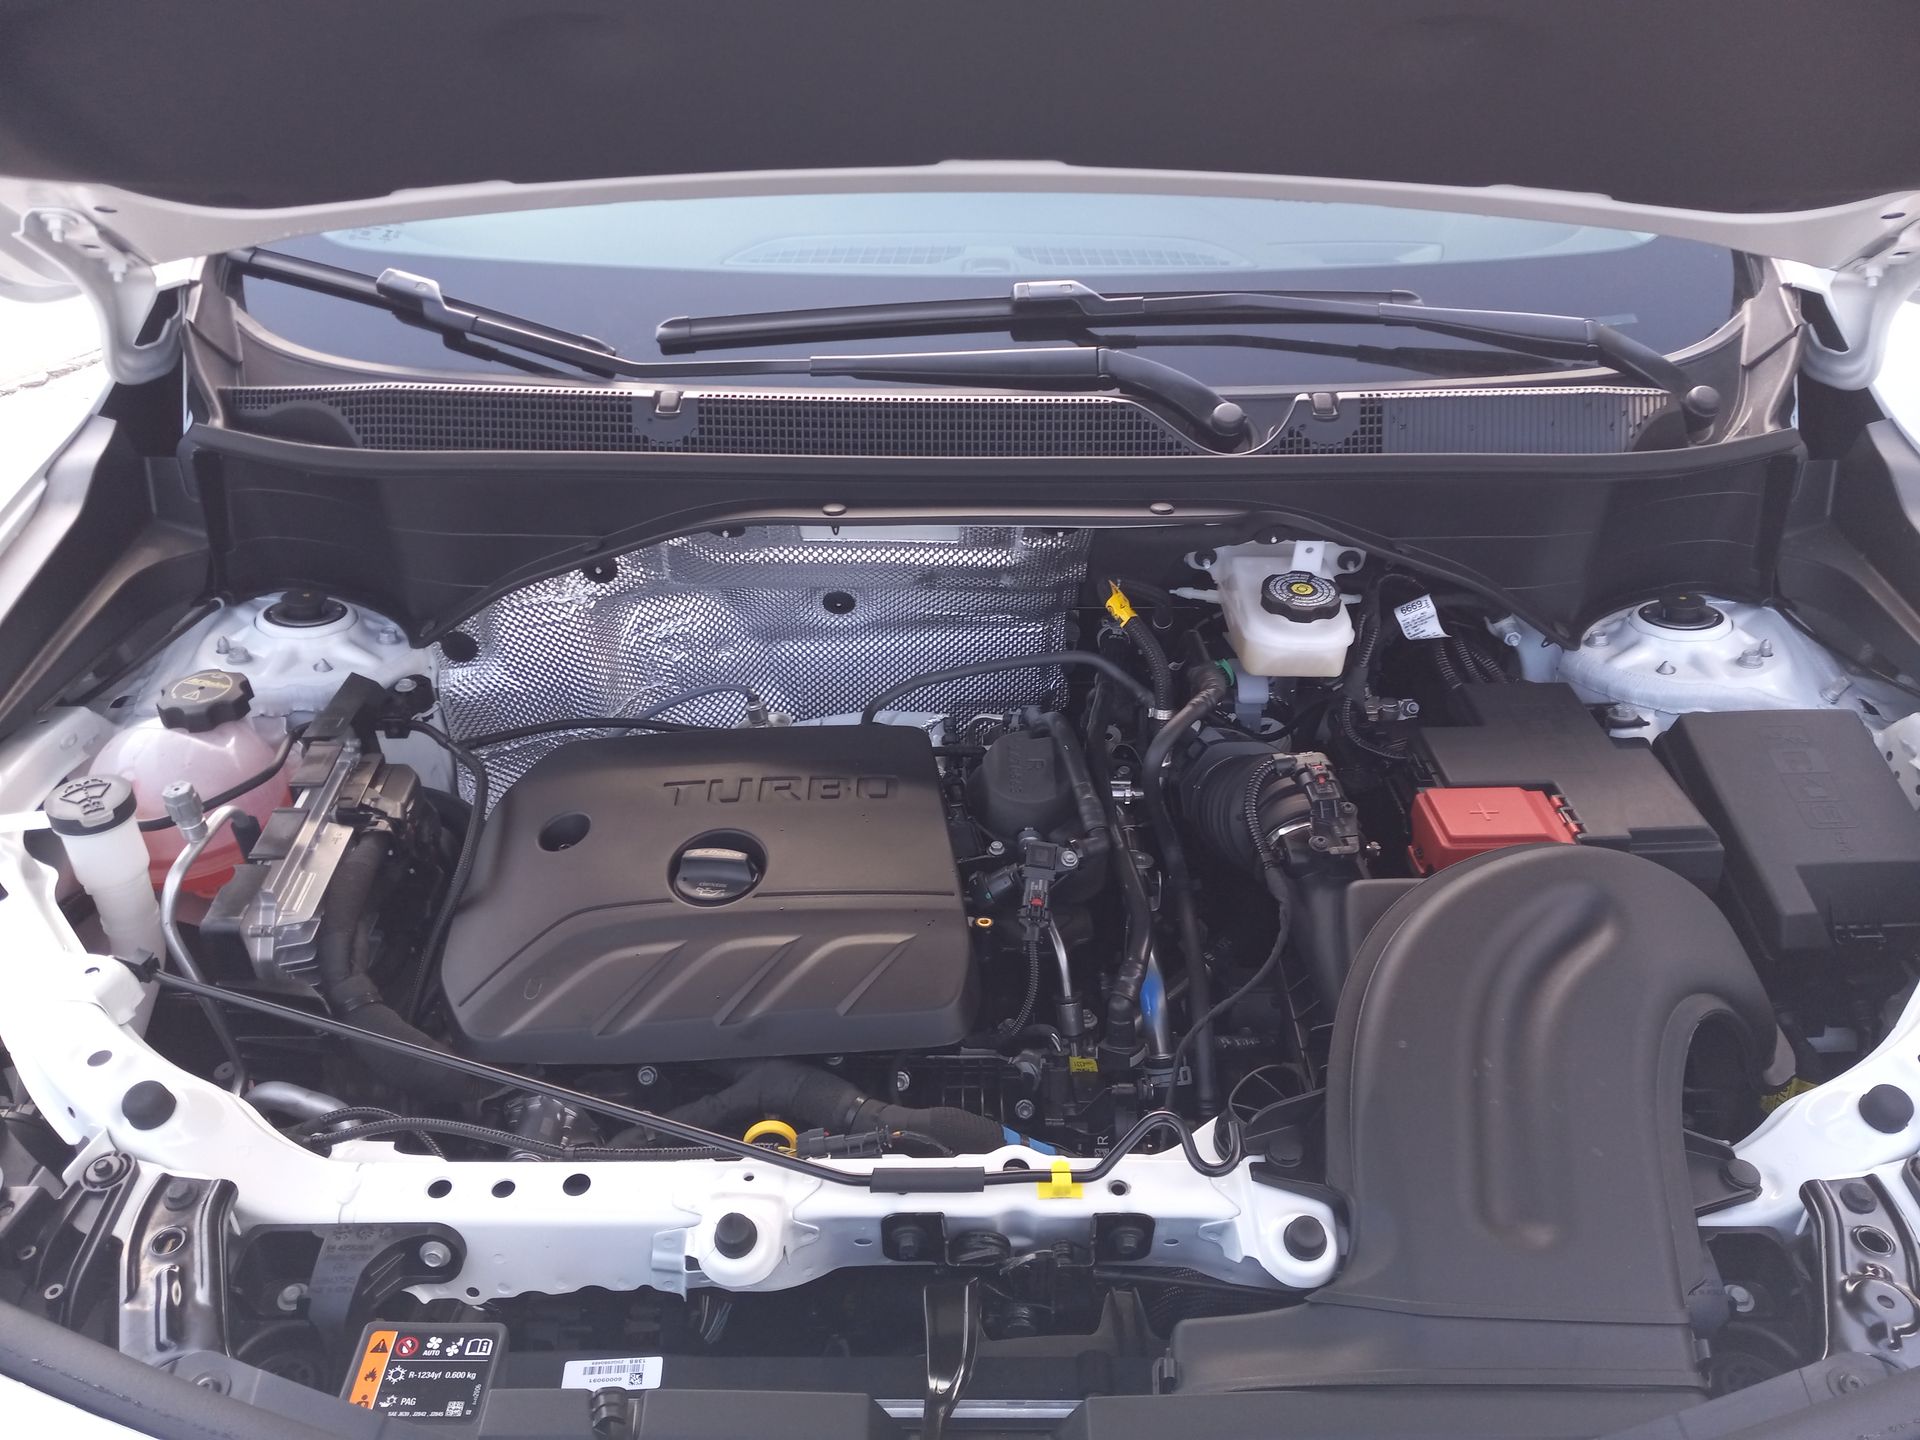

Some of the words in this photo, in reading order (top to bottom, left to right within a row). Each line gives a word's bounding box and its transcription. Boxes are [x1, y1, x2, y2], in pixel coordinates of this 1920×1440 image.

[1400, 600, 1423, 615] 6669
[663, 774, 900, 806] TURBO
[408, 1371, 442, 1380] R-1234yf
[445, 1371, 466, 1379] 0.600
[467, 1371, 477, 1380] kg
[400, 1397, 417, 1406] PAG
